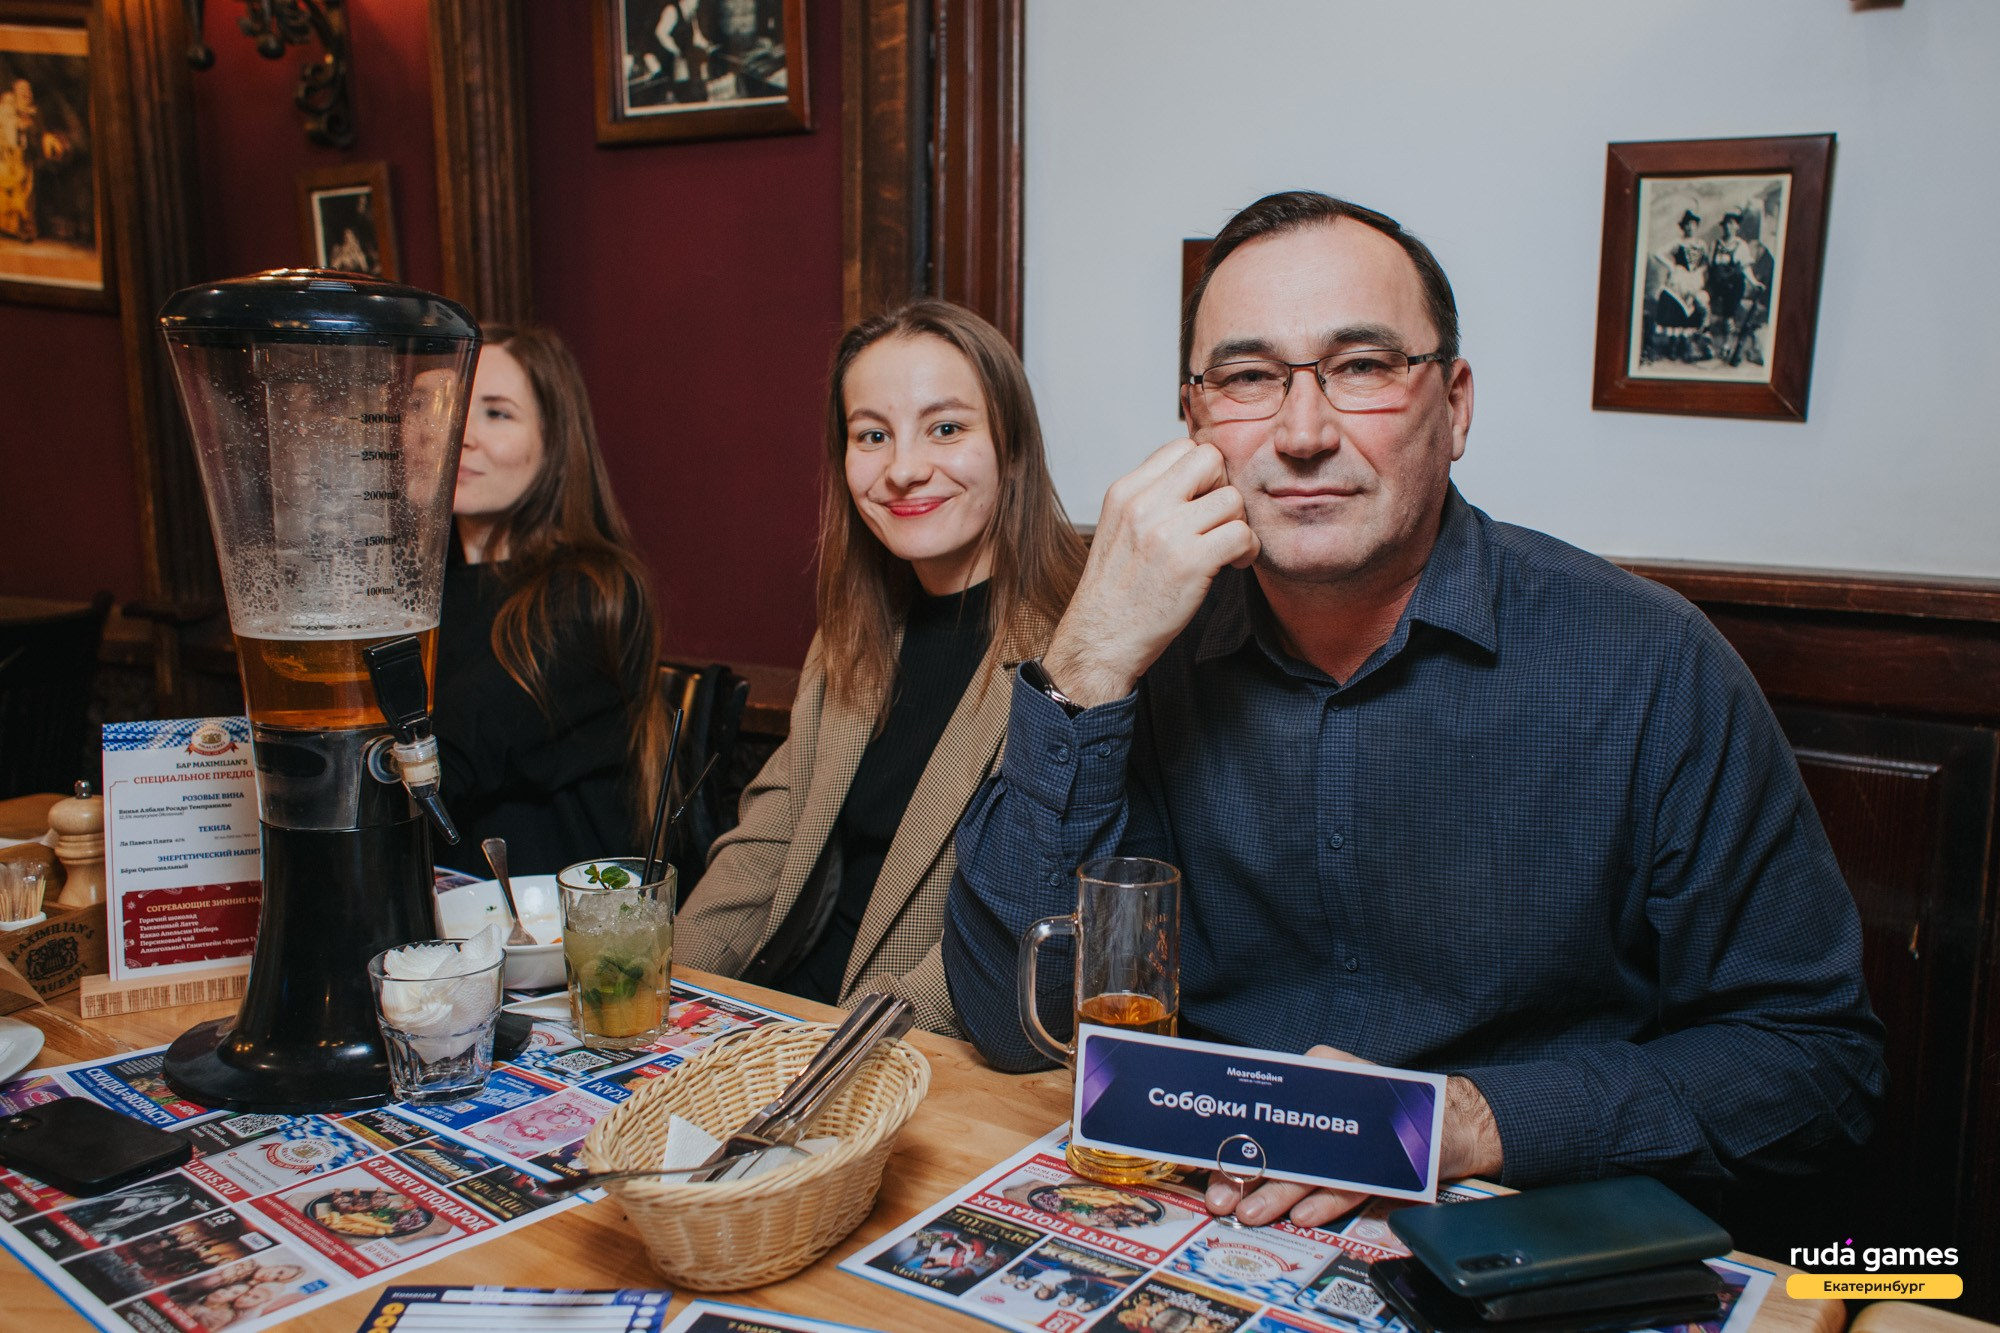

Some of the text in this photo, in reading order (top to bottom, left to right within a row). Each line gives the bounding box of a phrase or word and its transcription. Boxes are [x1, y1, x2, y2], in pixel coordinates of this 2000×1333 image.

[360, 413, 401, 424] 3000ml
[362, 450, 399, 461] 2500ml
[362, 490, 399, 501] 2000ml
[364, 535, 397, 546] 1500ml
[366, 586, 395, 597] 1000ml
[176, 758, 248, 770] БАР MAXIMILIAN'S
[133, 770, 256, 785] СПЕЦИАЛЬНОЕ ПРЕДЛО
[182, 791, 245, 802] РОЗОВЫЕ ВИНА
[198, 824, 232, 833] ТЕКИЛА
[157, 849, 233, 863] ЭНЕРГЕТИЧЕСКИЙ
[138, 863, 189, 873] Оригинальный
[146, 896, 262, 913] СОГРЕВАЮЩИЕ ЗИМНИЕ НА
[139, 912, 198, 924] Горячий шоколад
[139, 919, 199, 932] Тыквенный Латте
[139, 925, 220, 940] Какао Апельсин Имбирь
[139, 935, 195, 947] Персиковый чай
[139, 943, 186, 955] Алкогольный
[1226, 1067, 1284, 1084] Мозгобойня
[84, 1068, 178, 1126] СКИДКА=ВОЗРАСТУ
[1147, 1086, 1360, 1136] Соб@ки Павлова
[367, 1159, 378, 1169] 6
[374, 1162, 414, 1192] ЛАНЧ
[410, 1185, 423, 1197] В
[418, 1190, 491, 1233] ПОДАРОК
[212, 1211, 237, 1226] 15
[970, 1194, 1070, 1234] ПОДАРОК
[1068, 1225, 1086, 1238] В
[1085, 1228, 1147, 1257] ЛАНЧ
[1279, 1220, 1401, 1260] XIMILIANS.
[1144, 1250, 1161, 1262] 6
[391, 1291, 438, 1300] Команда
